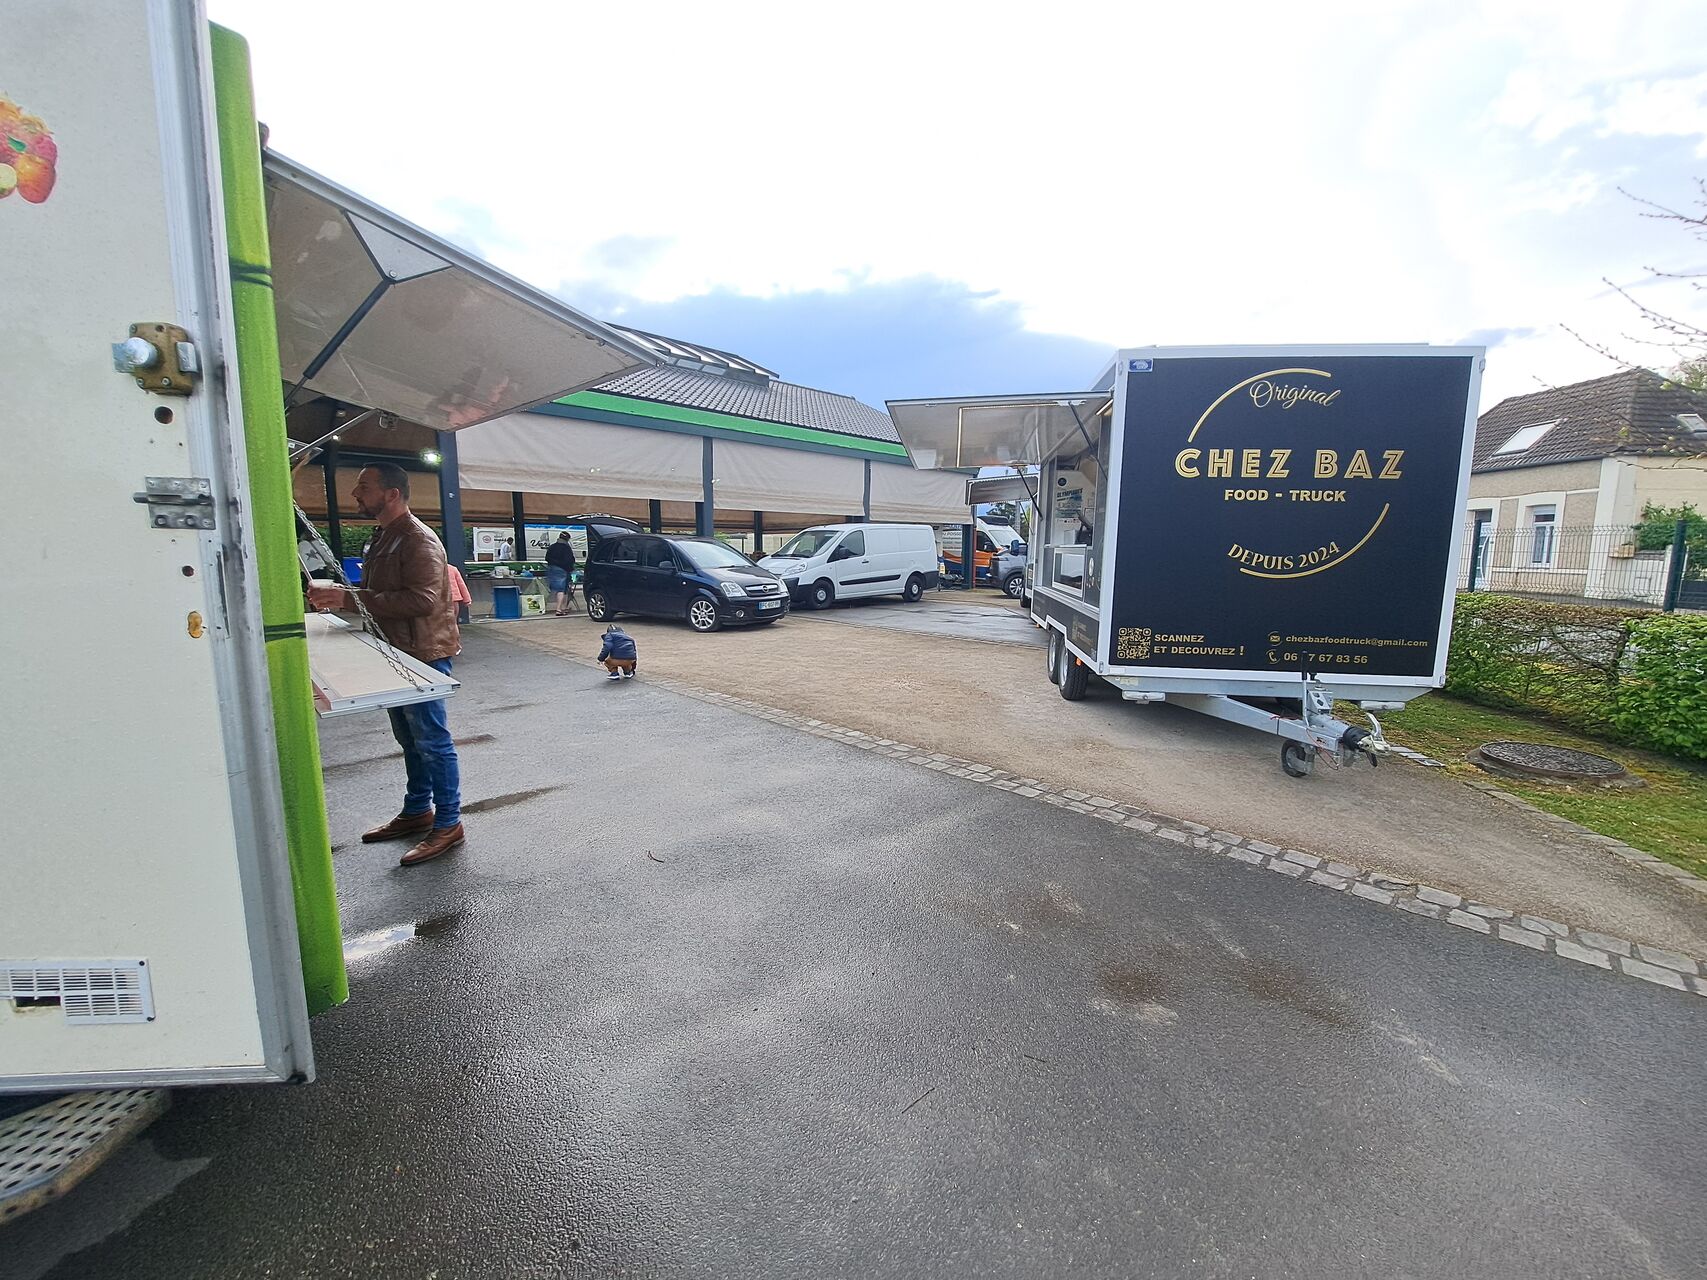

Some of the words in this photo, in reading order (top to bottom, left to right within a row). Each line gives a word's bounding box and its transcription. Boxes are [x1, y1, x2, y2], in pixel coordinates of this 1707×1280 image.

[1249, 380, 1341, 409] Original
[1175, 448, 1292, 478] CHEZ
[1314, 449, 1404, 479] BAZ
[1224, 489, 1269, 501] FOOD
[1289, 490, 1346, 502] TRUCK
[1227, 543, 1294, 570] DEPUIS
[1299, 541, 1341, 569] 2024
[1154, 634, 1205, 643] SCANNEZ
[1285, 635, 1428, 648] chezbazfoodtruck@gmail.com
[1153, 646, 1167, 654] ET
[1171, 646, 1236, 656] DECOUVREZ
[1283, 652, 1298, 662] 06
[1318, 654, 1332, 663] 67
[1336, 655, 1350, 663] 83
[1353, 655, 1368, 664] 56
